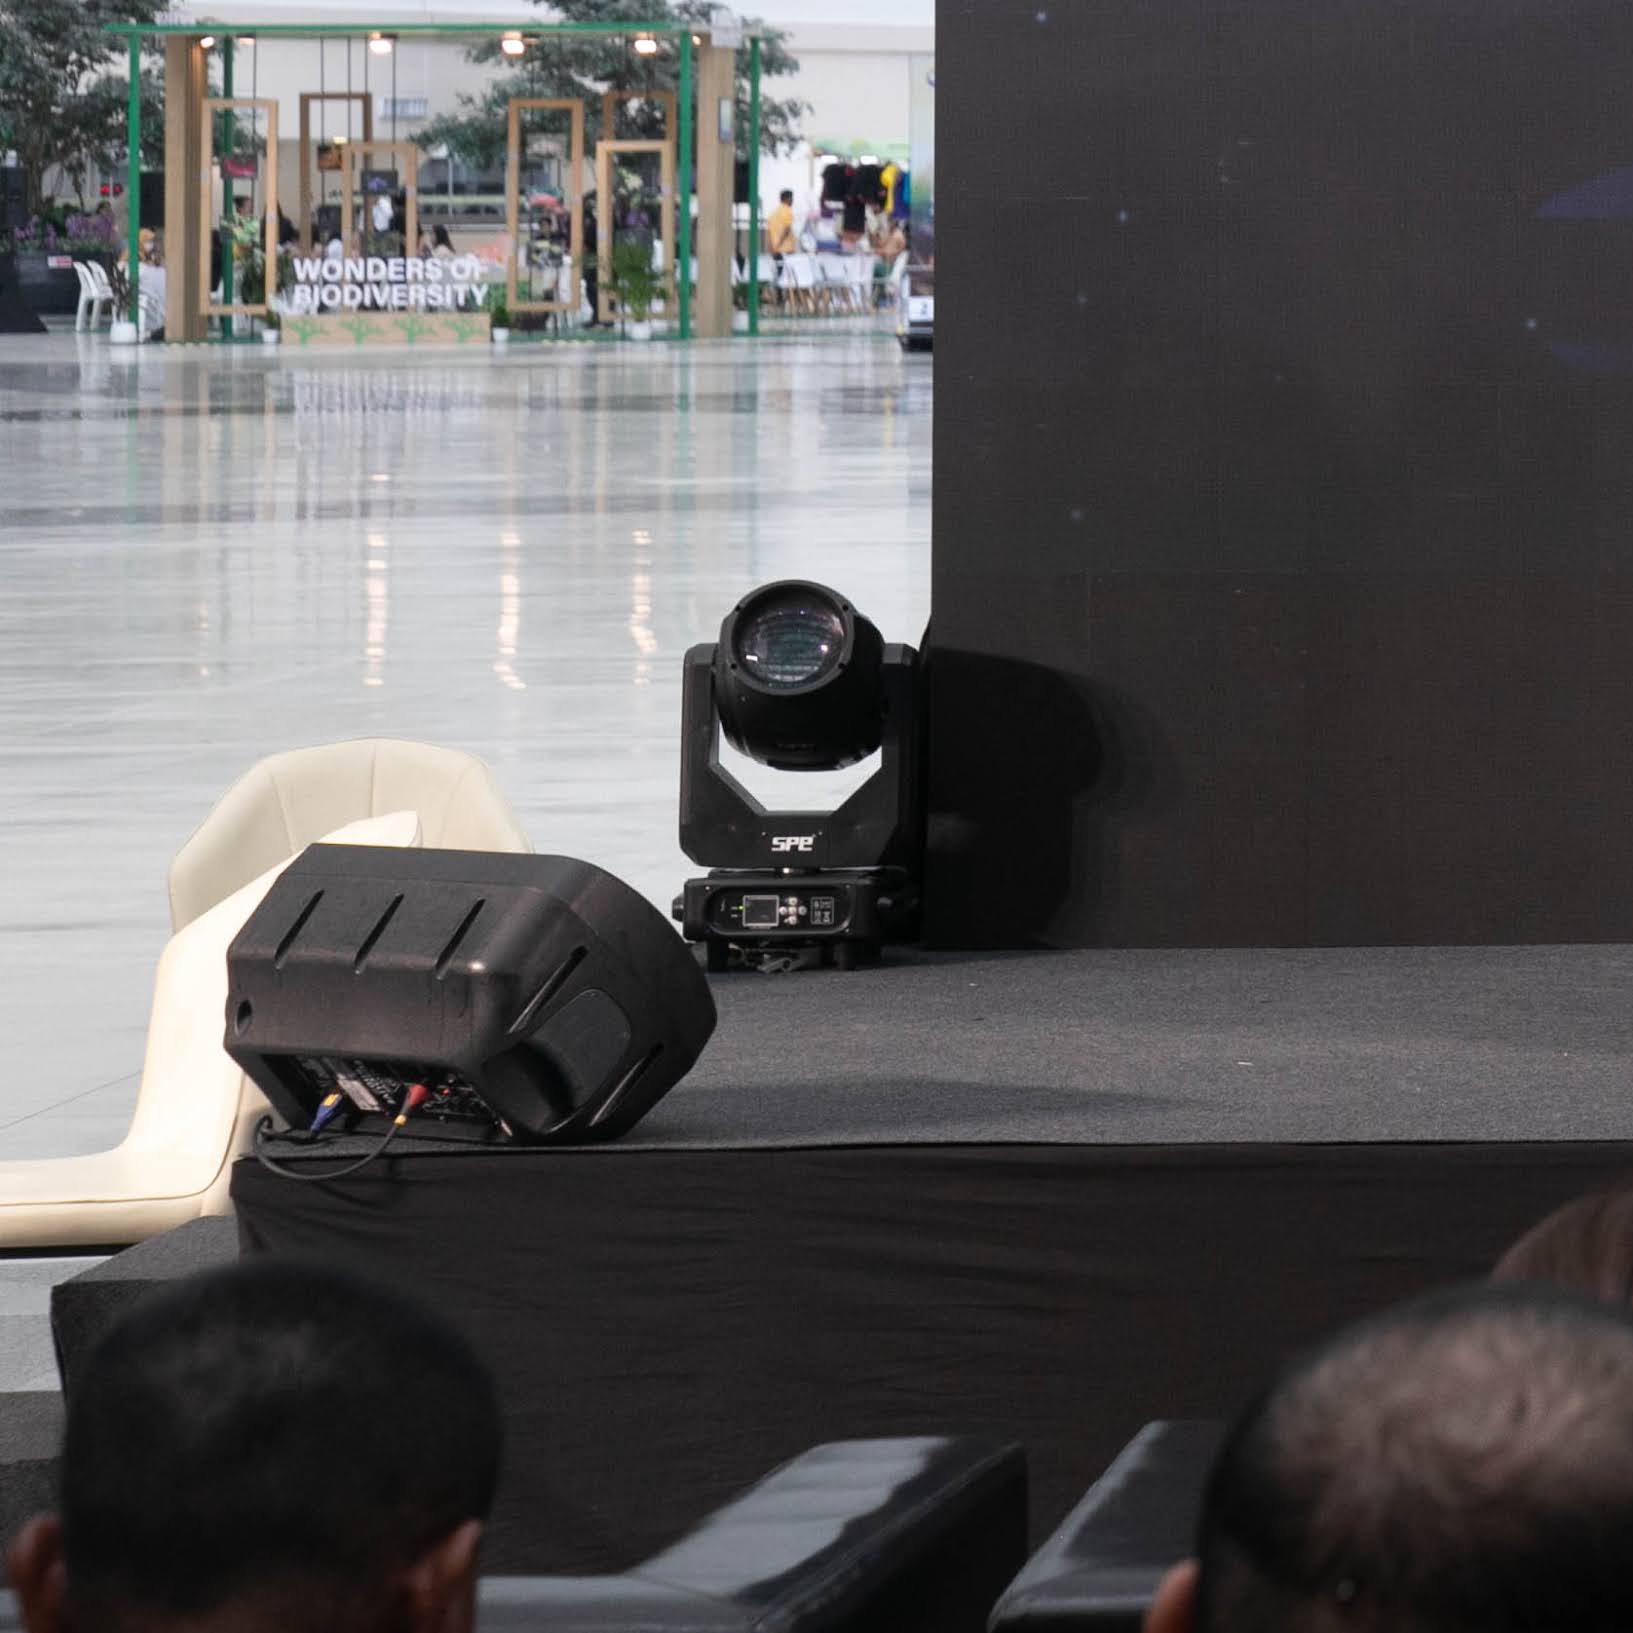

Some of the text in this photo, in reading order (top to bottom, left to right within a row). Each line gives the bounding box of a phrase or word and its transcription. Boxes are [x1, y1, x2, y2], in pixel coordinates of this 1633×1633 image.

[293, 255, 489, 283] WONDERS OF
[291, 283, 489, 307] BIODIVERSITY
